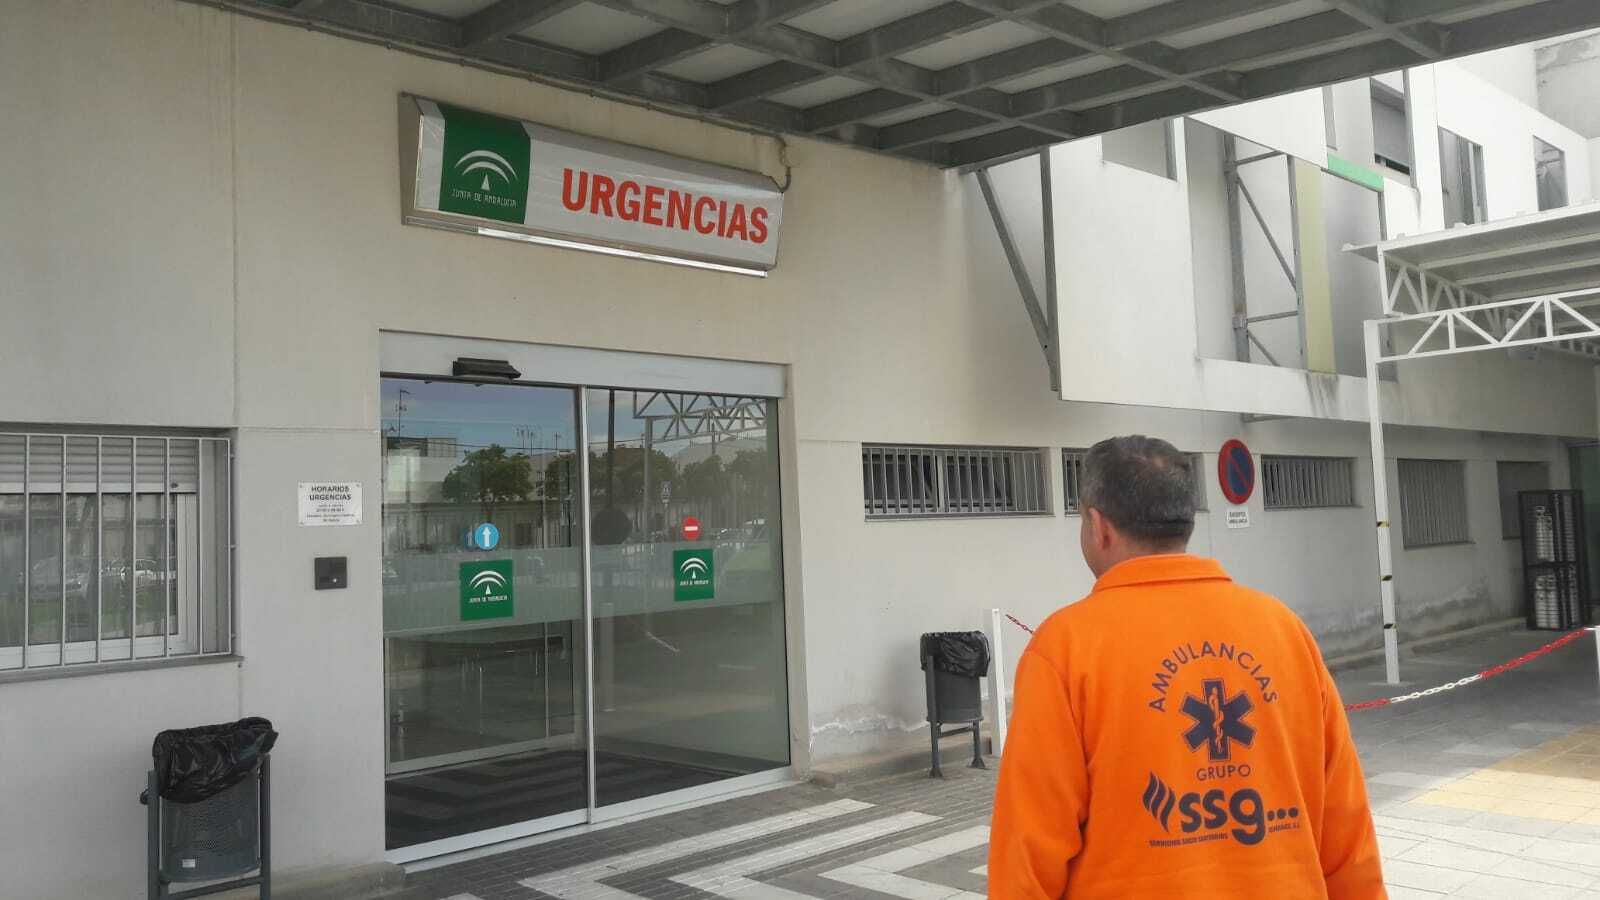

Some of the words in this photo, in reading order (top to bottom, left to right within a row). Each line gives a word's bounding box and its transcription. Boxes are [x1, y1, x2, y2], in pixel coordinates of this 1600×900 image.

[474, 192, 482, 202] DE
[562, 168, 768, 244] URGENCIAS
[1149, 641, 1278, 713] AMBULANCIAS
[1196, 764, 1252, 782] GRUPO
